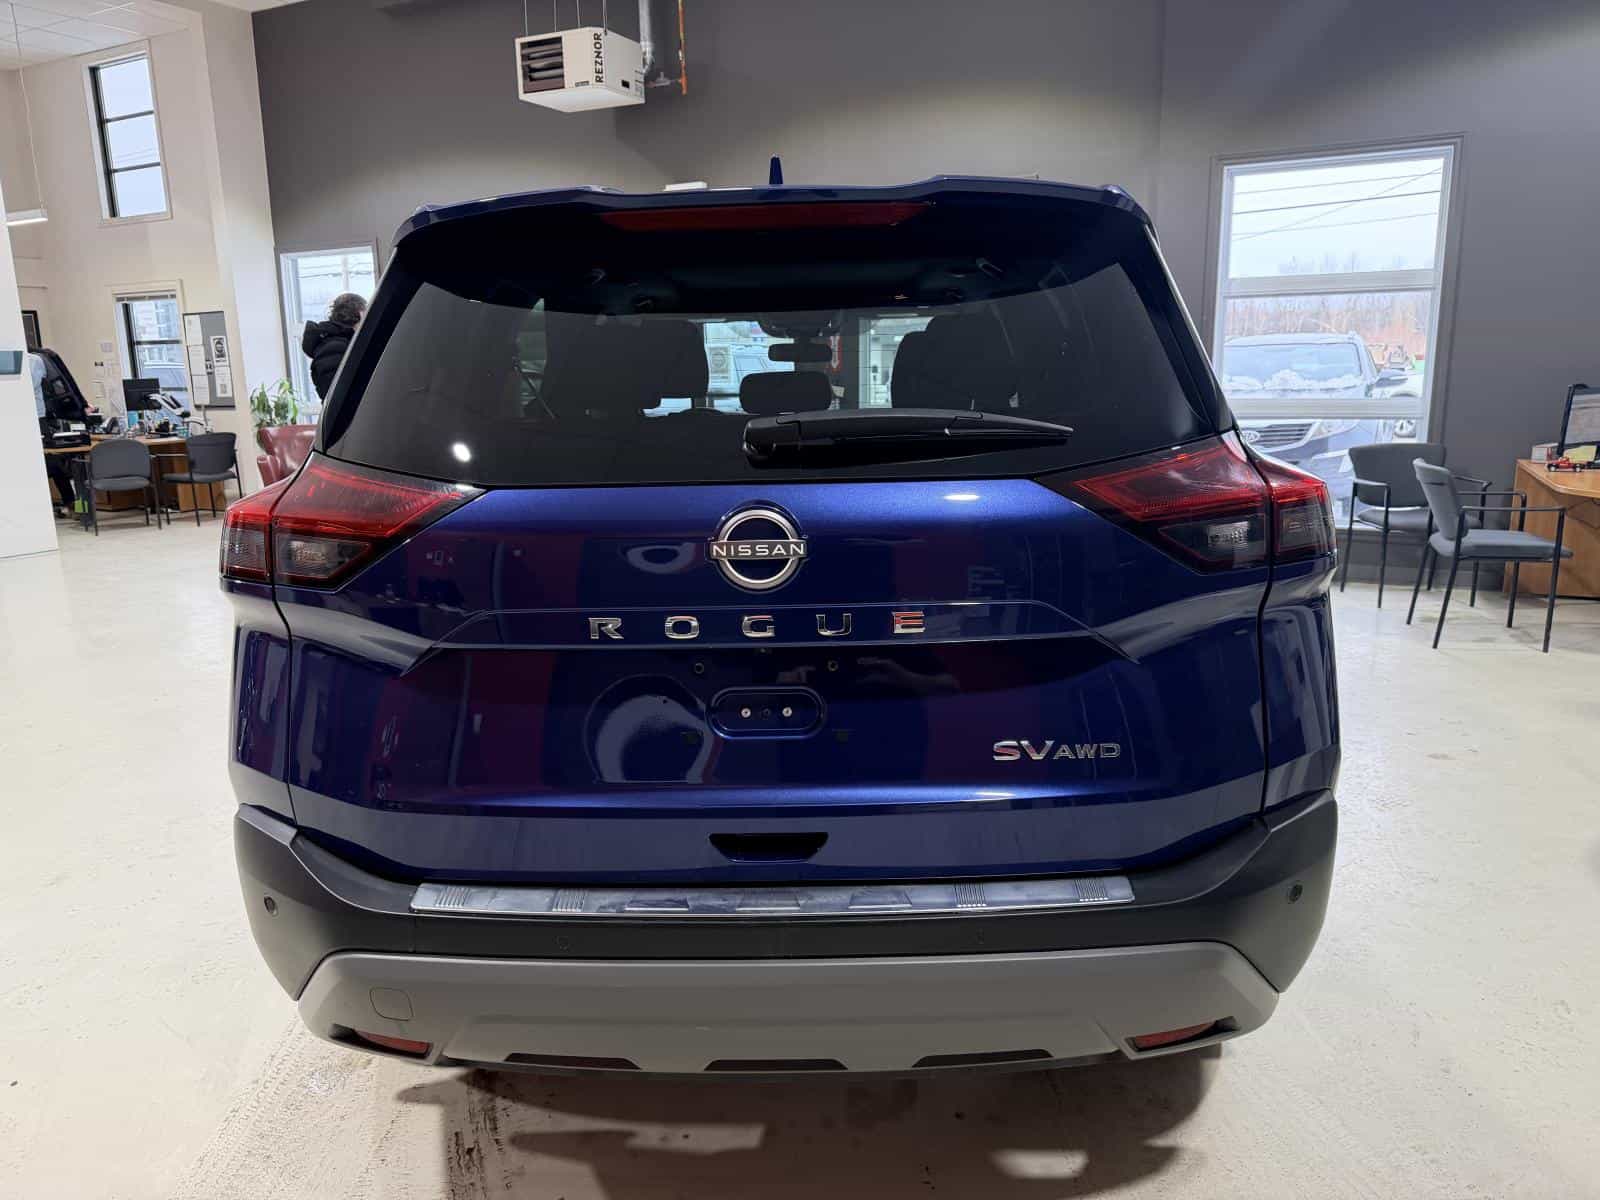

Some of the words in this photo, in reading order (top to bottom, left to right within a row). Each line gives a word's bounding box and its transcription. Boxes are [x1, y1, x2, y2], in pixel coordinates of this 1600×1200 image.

[593, 32, 604, 83] REZNOR
[712, 542, 805, 557] NISSAN
[588, 611, 926, 639] ROGUE
[993, 740, 1055, 761] SV
[1053, 743, 1121, 760] AWD
